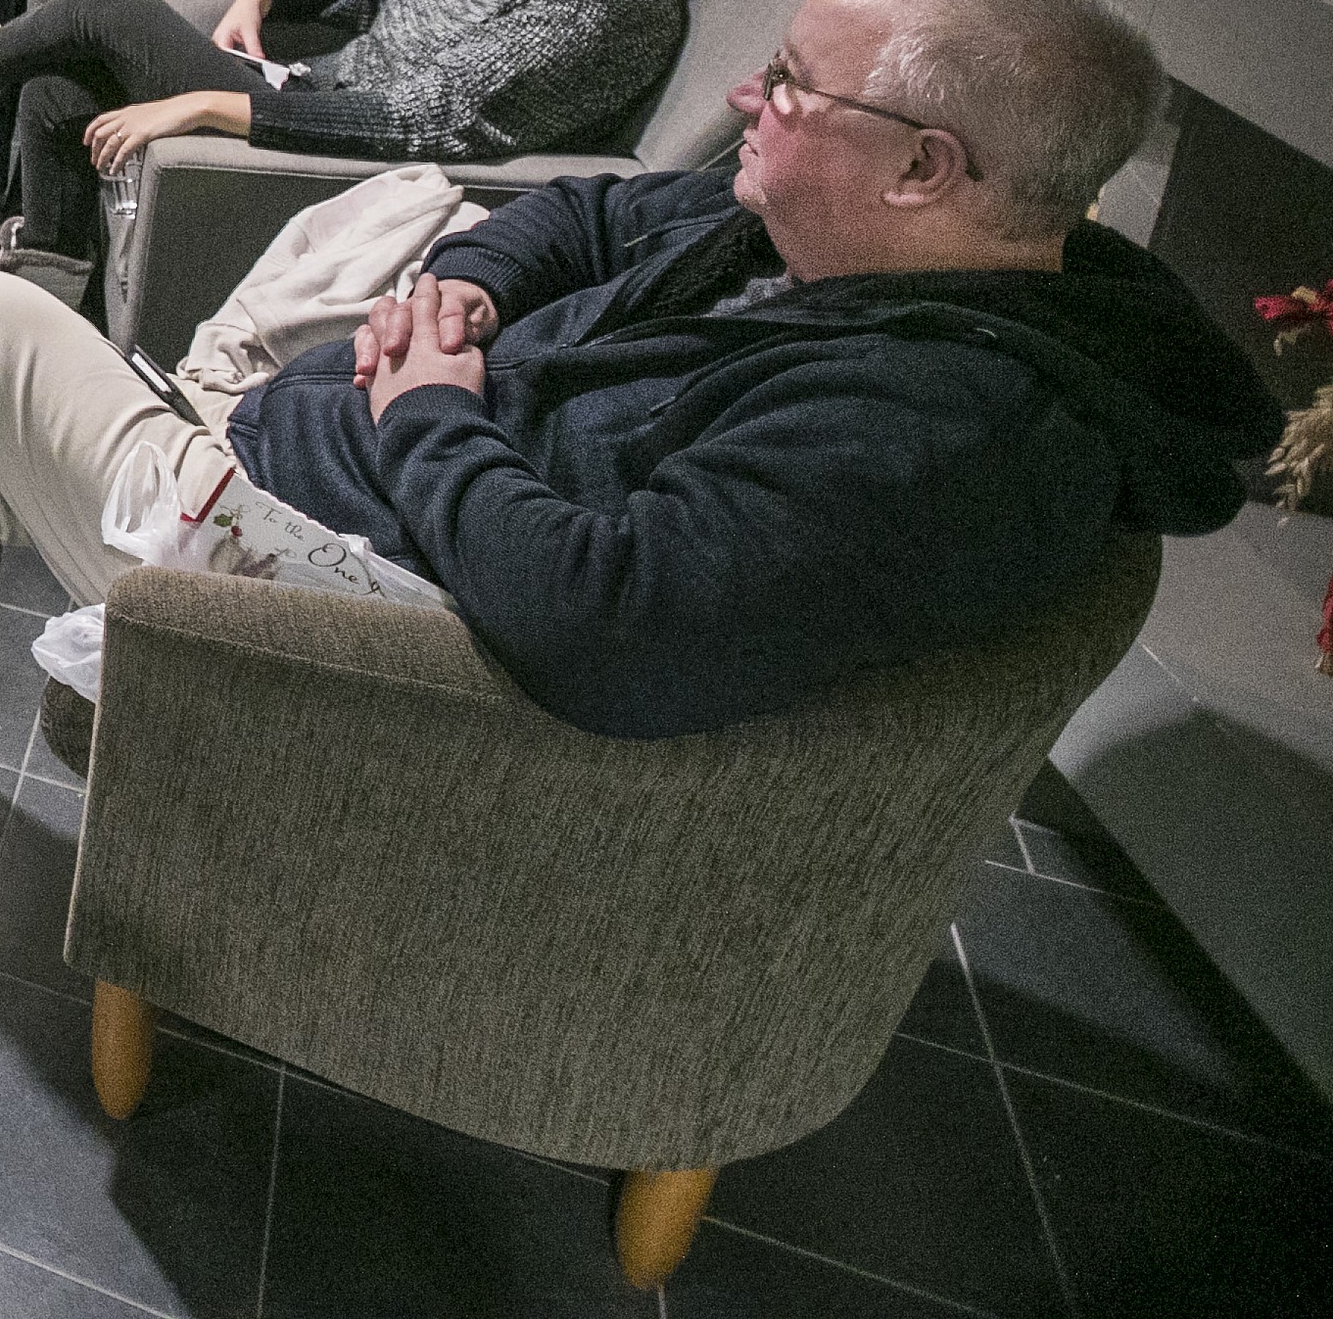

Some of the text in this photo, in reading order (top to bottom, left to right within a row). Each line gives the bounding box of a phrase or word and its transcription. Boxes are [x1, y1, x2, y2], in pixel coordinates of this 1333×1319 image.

[255, 502, 282, 523] To
[284, 522, 305, 542] the
[308, 542, 360, 586] One
